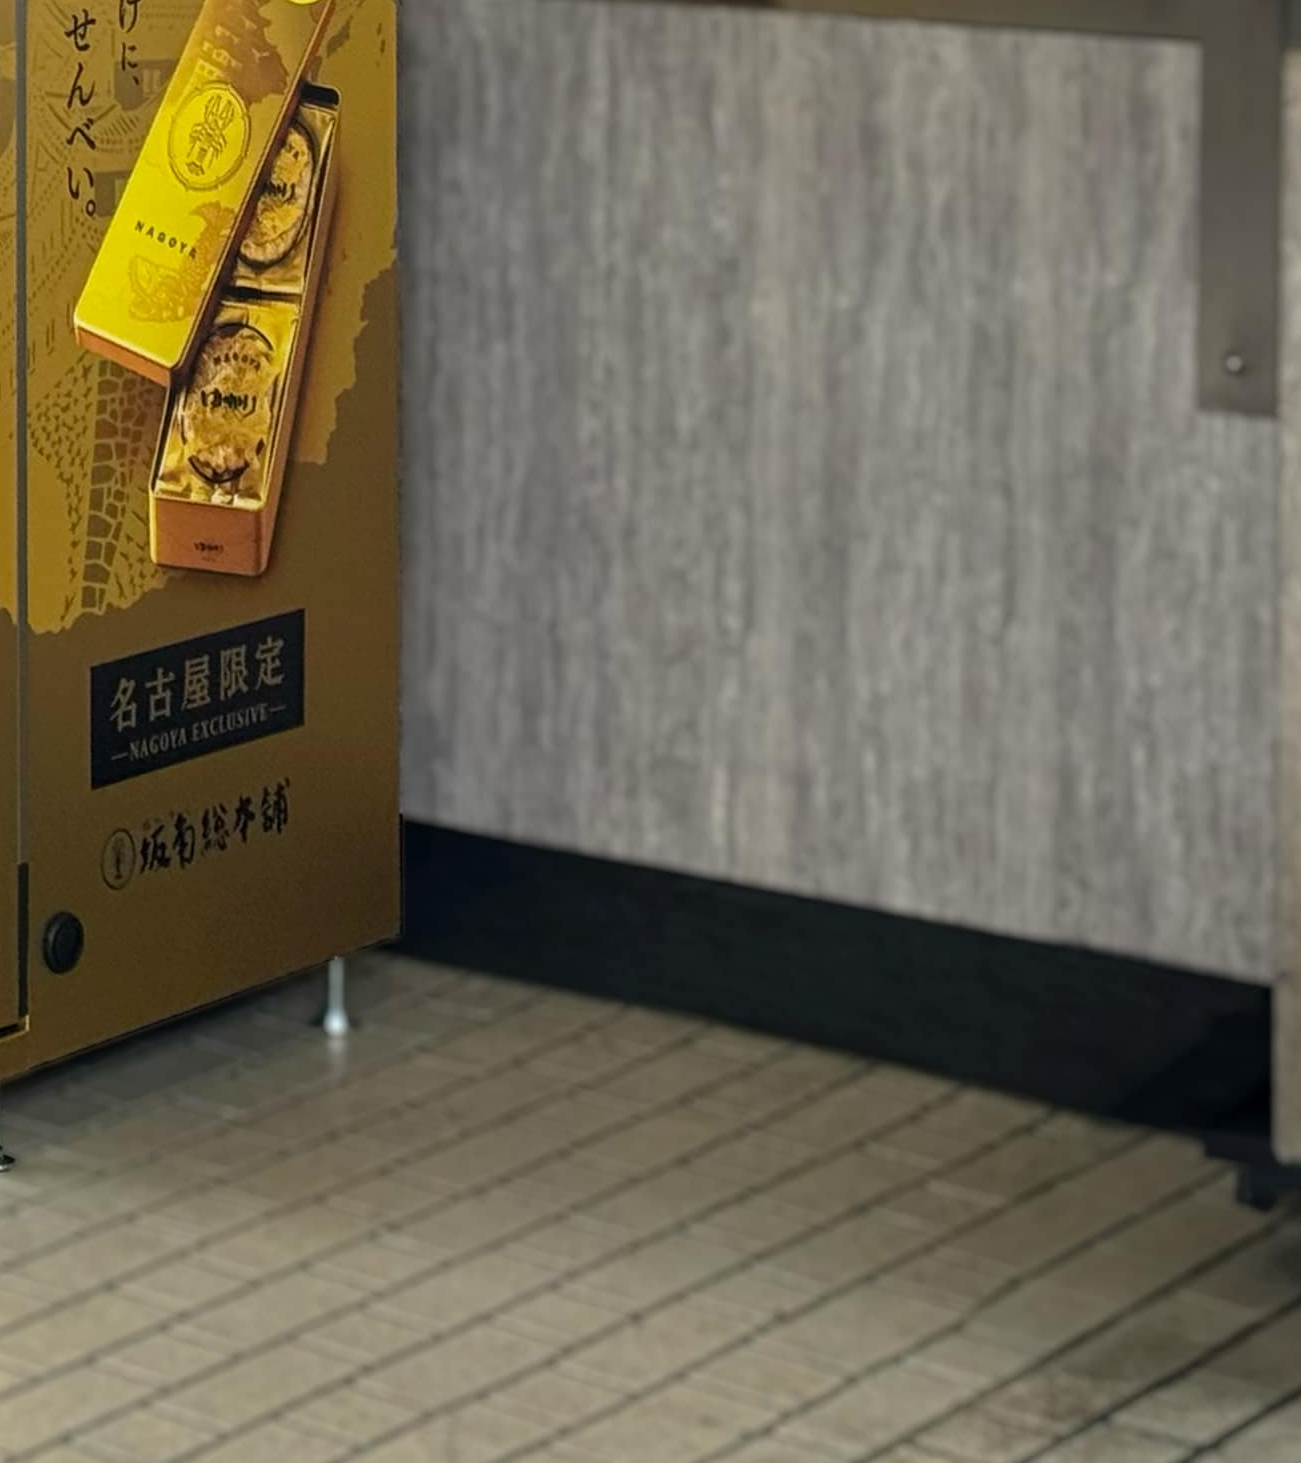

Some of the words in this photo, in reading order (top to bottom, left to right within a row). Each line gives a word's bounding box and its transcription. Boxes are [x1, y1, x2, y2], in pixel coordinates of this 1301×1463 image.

[134, 218, 199, 261] NAGOYA
[109, 636, 285, 733] 名古屋限定
[129, 726, 188, 762] NAGOYA
[191, 701, 269, 742] EXCLUSIVE
